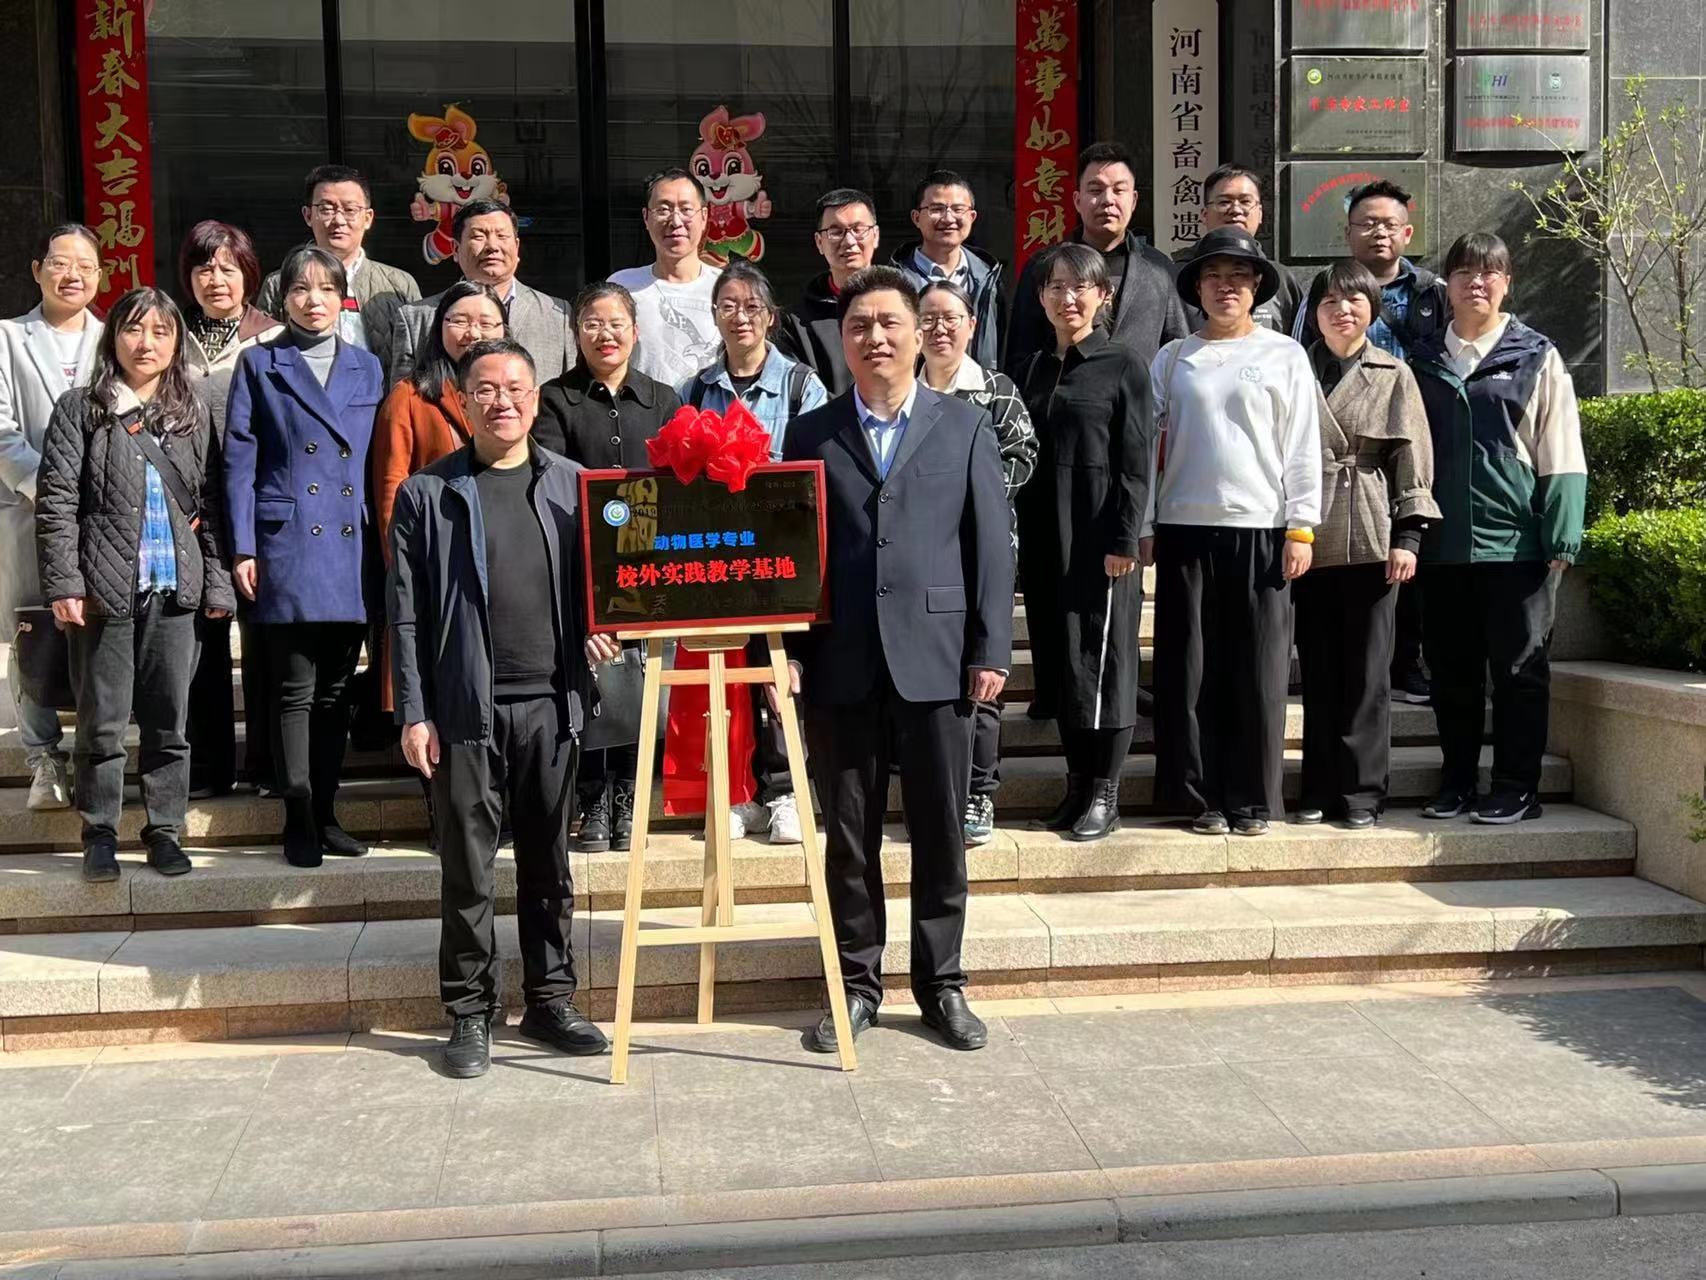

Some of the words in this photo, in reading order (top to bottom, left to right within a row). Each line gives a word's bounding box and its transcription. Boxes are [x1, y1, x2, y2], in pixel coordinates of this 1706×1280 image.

[1169, 27, 1204, 242] 河南省畜禽遗
[653, 530, 756, 551] 动物医学专业
[615, 556, 797, 588] 校外实践教学基地
